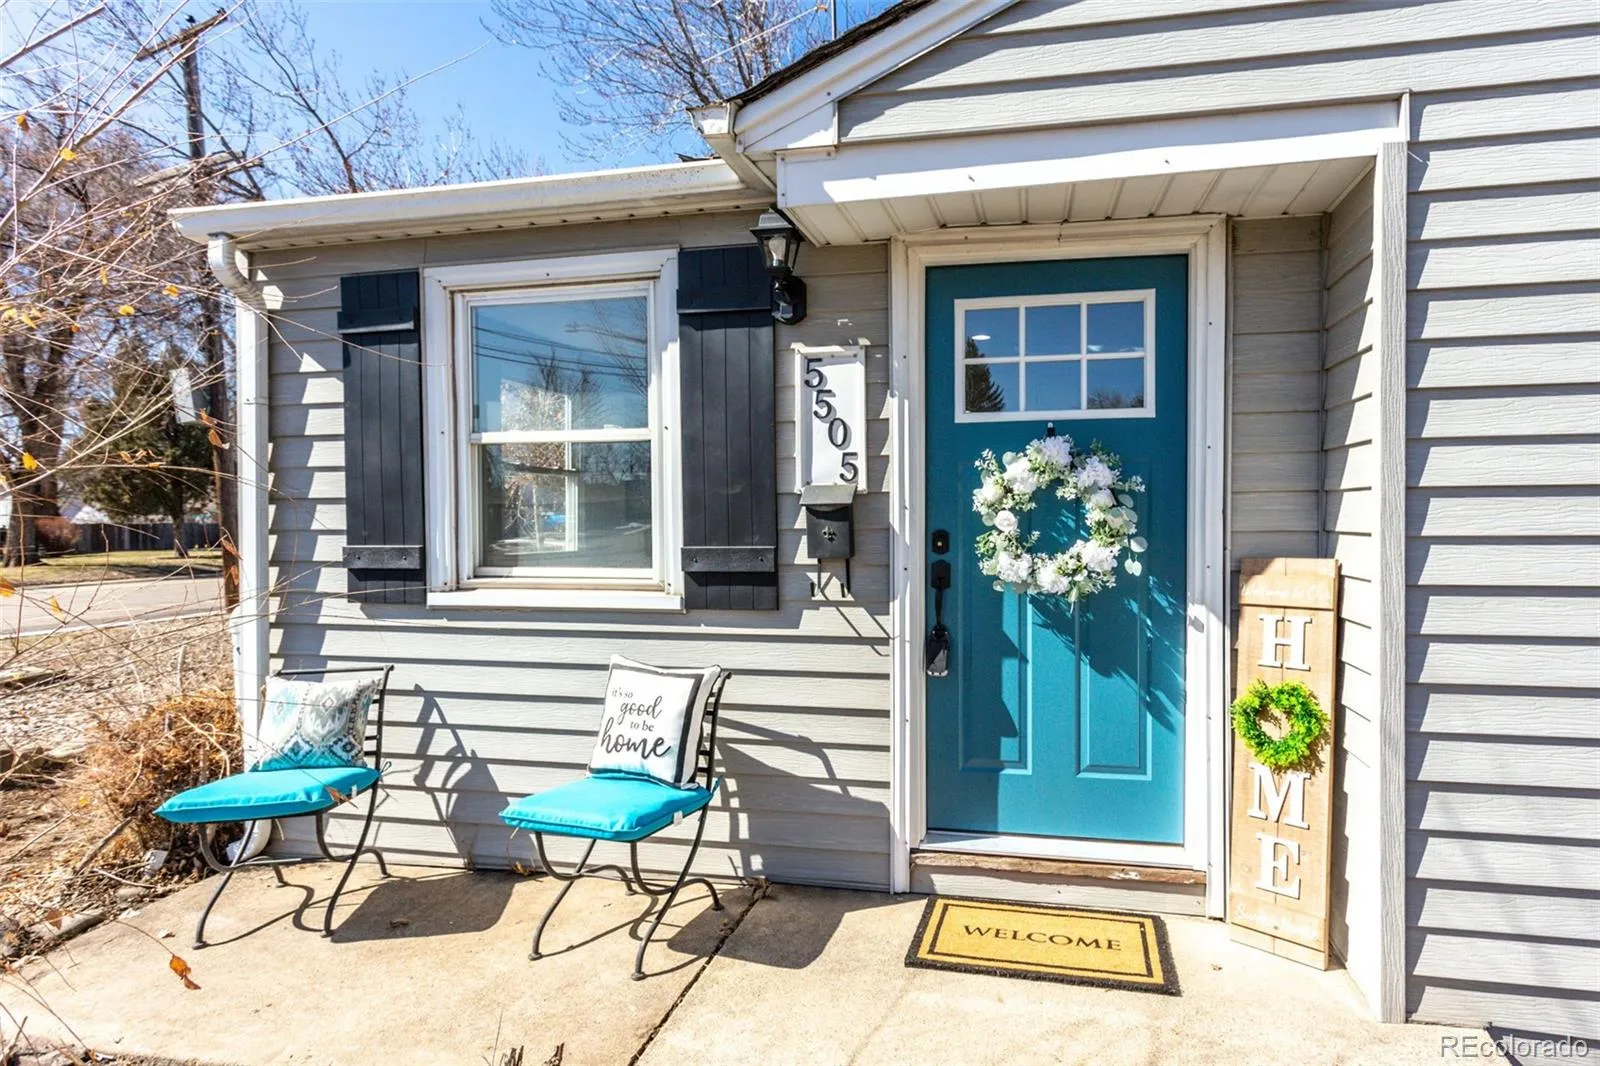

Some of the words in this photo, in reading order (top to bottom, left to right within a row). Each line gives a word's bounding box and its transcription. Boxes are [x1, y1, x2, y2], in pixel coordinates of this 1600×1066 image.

[804, 357, 858, 482] 5505
[611, 687, 623, 697] it's
[617, 696, 662, 725] good
[601, 717, 671, 759] home
[630, 720, 640, 730] to
[641, 719, 655, 732] be
[963, 925, 1122, 951] WELCOME
